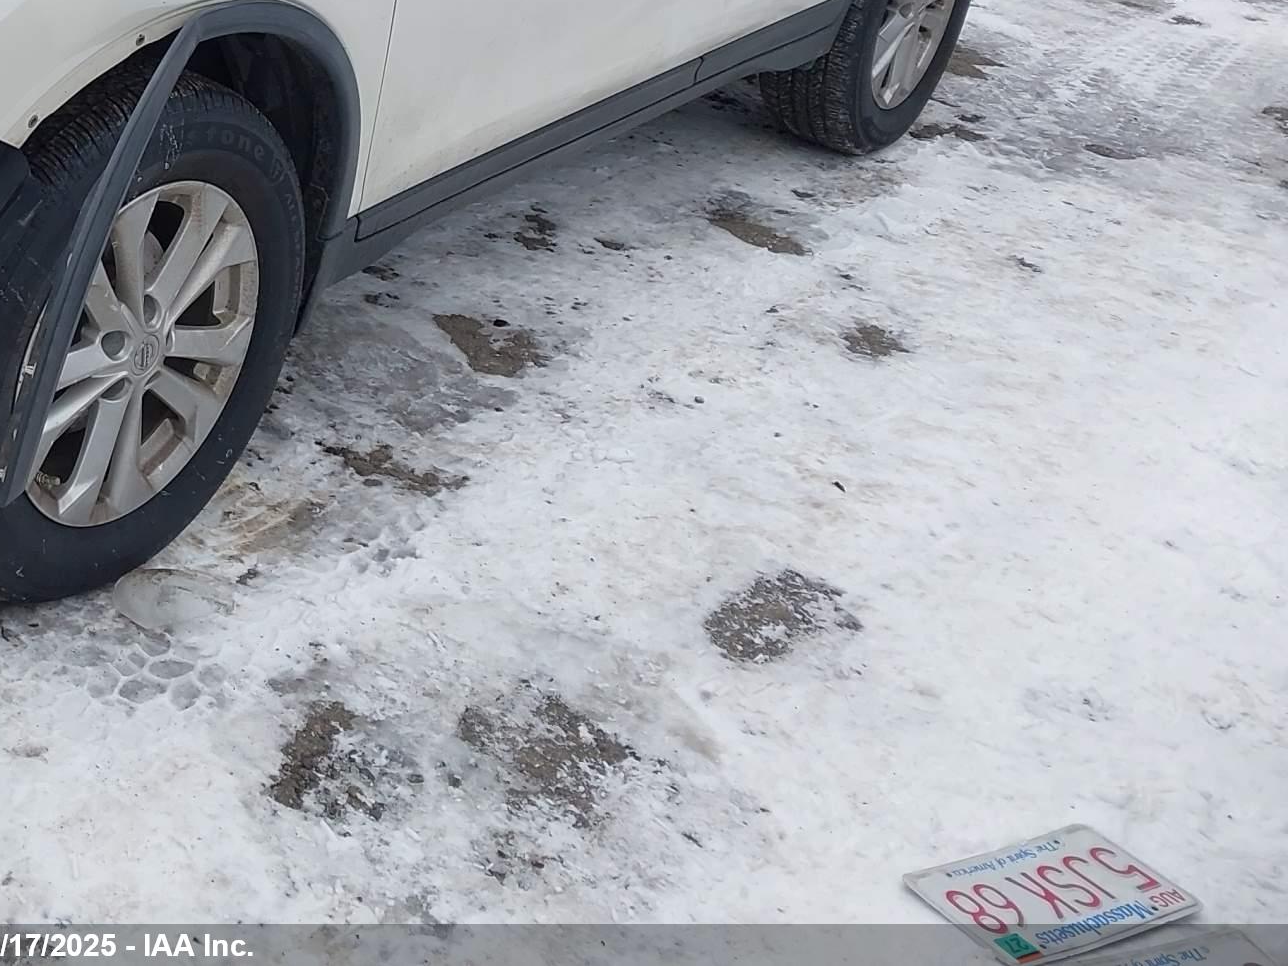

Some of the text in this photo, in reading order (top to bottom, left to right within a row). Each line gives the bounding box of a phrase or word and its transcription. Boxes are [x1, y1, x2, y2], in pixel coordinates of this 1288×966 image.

[1006, 847, 1038, 863] Spirit
[1035, 843, 1059, 852] The
[995, 857, 1007, 868] of
[1150, 888, 1186, 908] AUG
[1035, 900, 1154, 945] Massachusetts
[1004, 937, 1029, 954] 27
